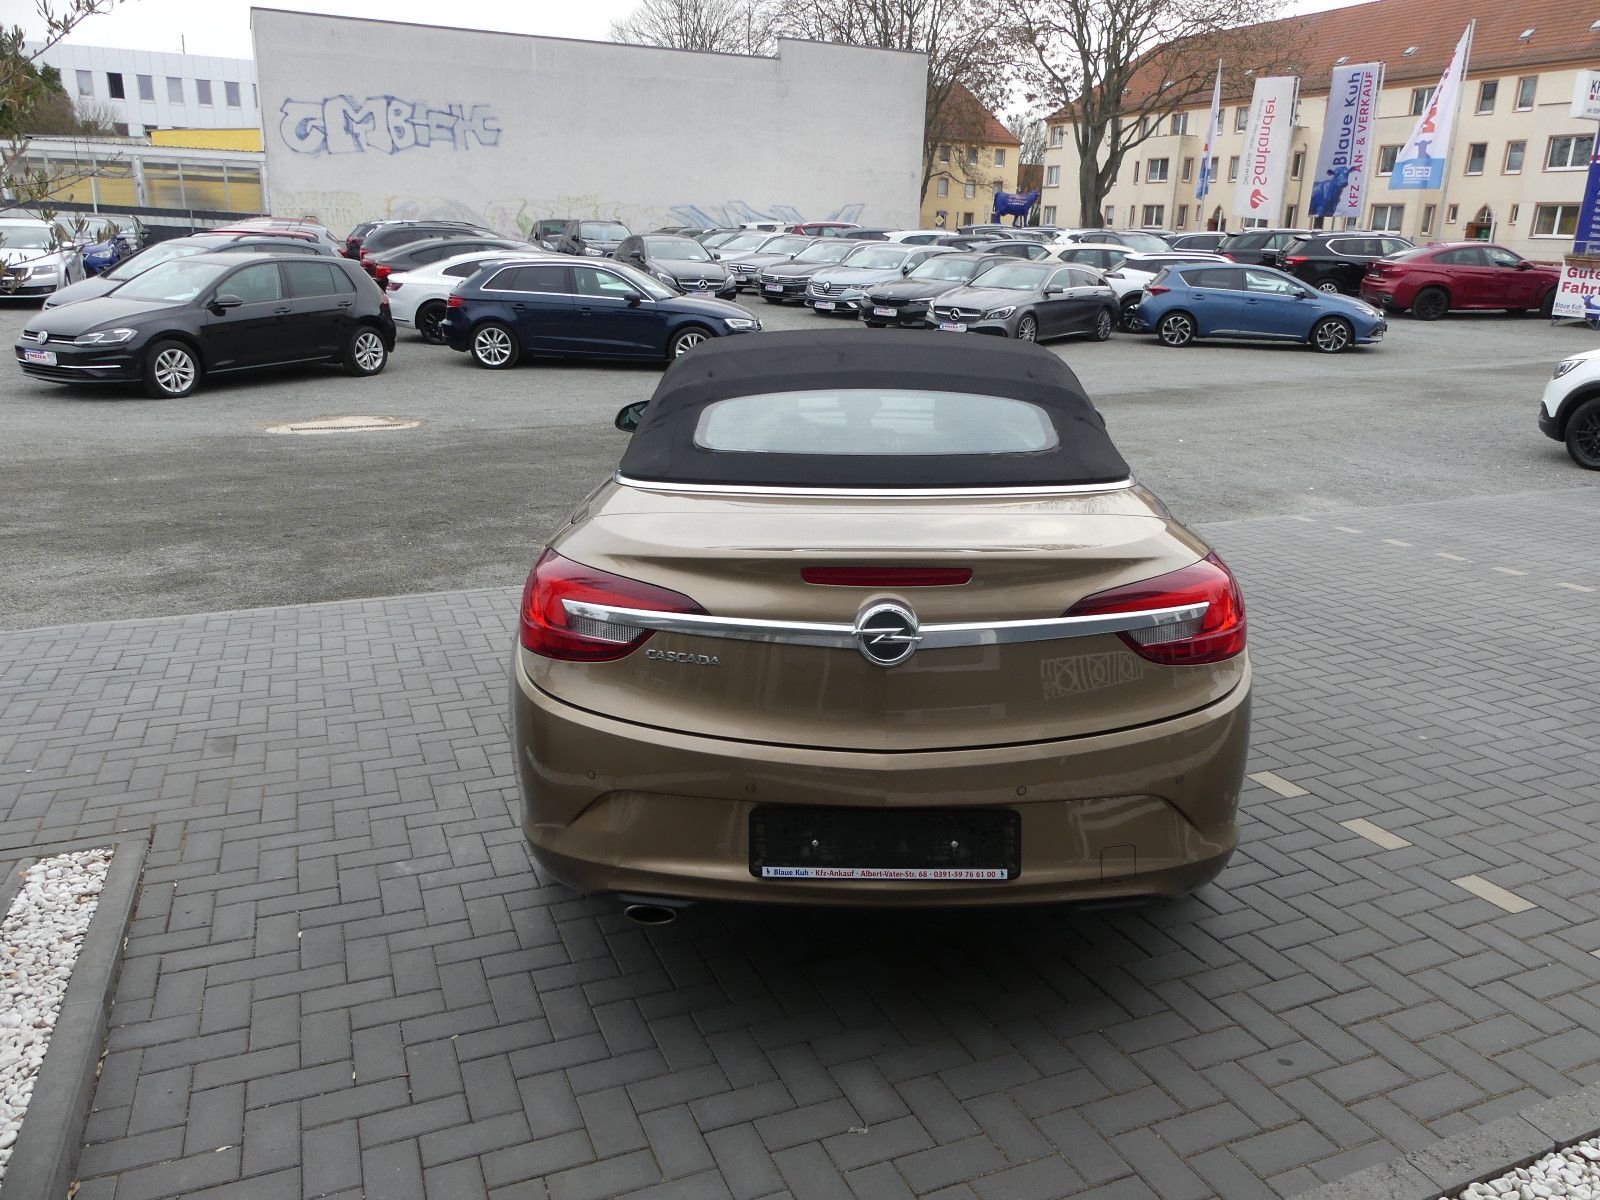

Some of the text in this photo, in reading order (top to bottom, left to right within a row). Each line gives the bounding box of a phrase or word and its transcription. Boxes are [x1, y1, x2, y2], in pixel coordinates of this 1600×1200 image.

[1358, 71, 1374, 133] VERKAUF
[1333, 72, 1361, 166] Blaue Kuh
[1356, 137, 1366, 146] &
[1348, 184, 1360, 208] KFZ
[645, 649, 721, 666] CASCADA
[773, 868, 996, 878] Blaue Kuh Kfz-Ankauf Albert-Vater-Str. 68 0391-59 76 61 00
